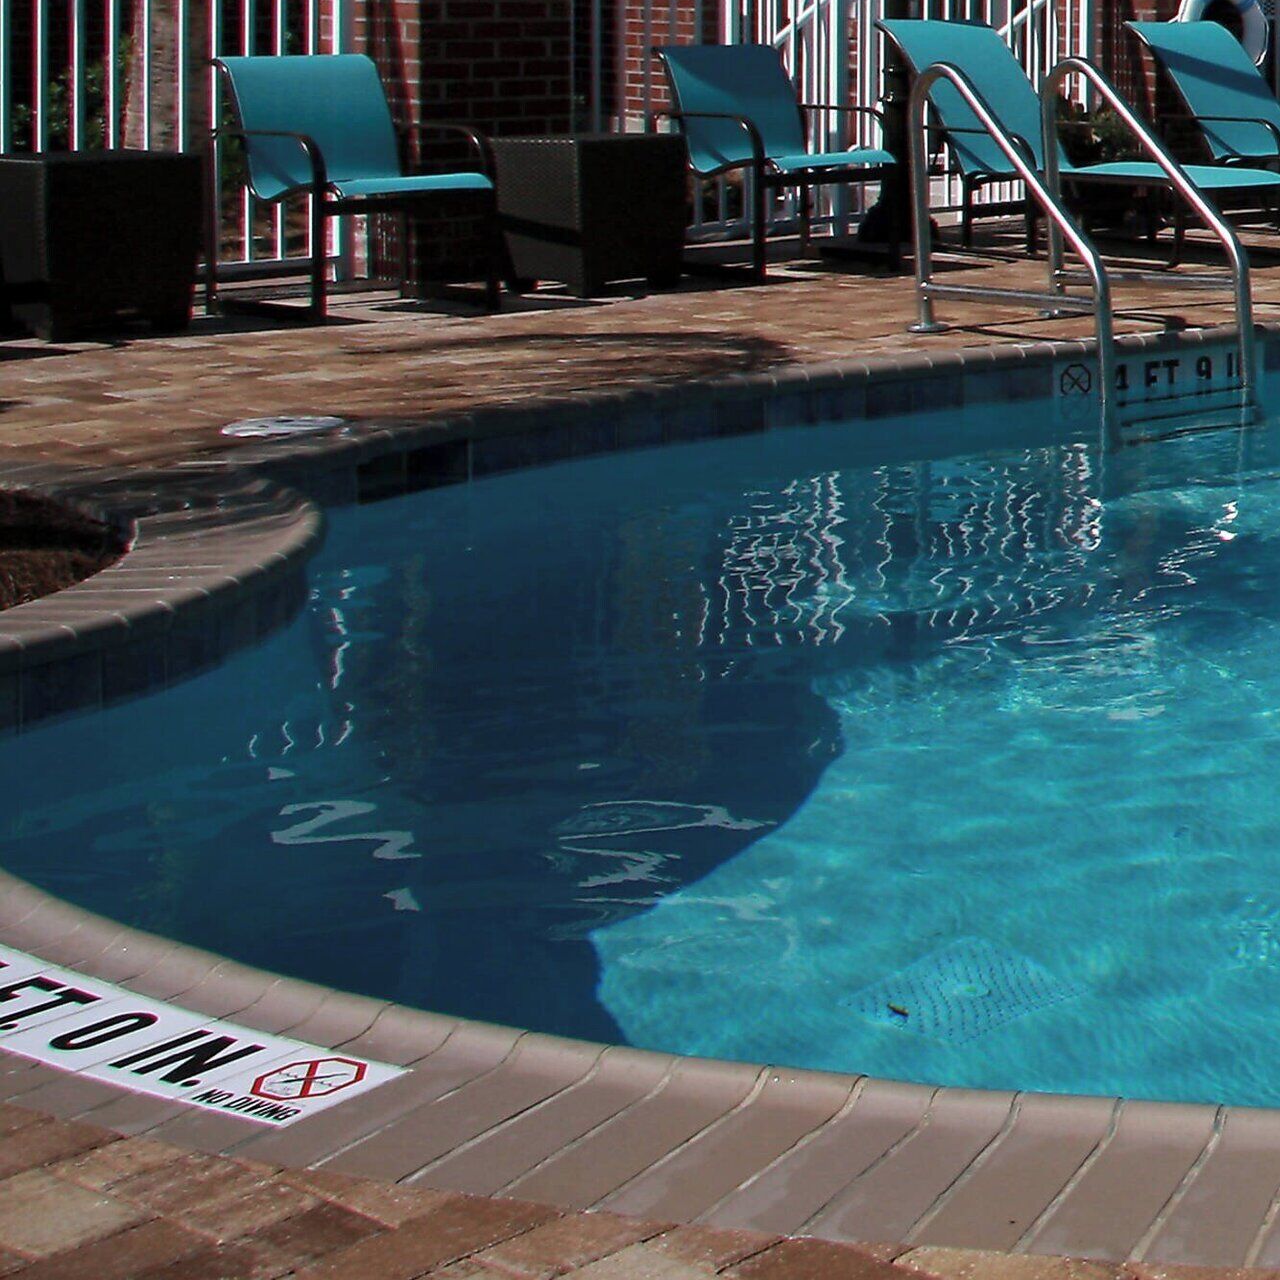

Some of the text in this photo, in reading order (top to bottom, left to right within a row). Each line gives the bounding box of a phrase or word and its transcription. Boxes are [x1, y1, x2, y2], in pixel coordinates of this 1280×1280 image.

[1144, 358, 1179, 387] FT
[191, 1088, 302, 1122] NO DIVING
